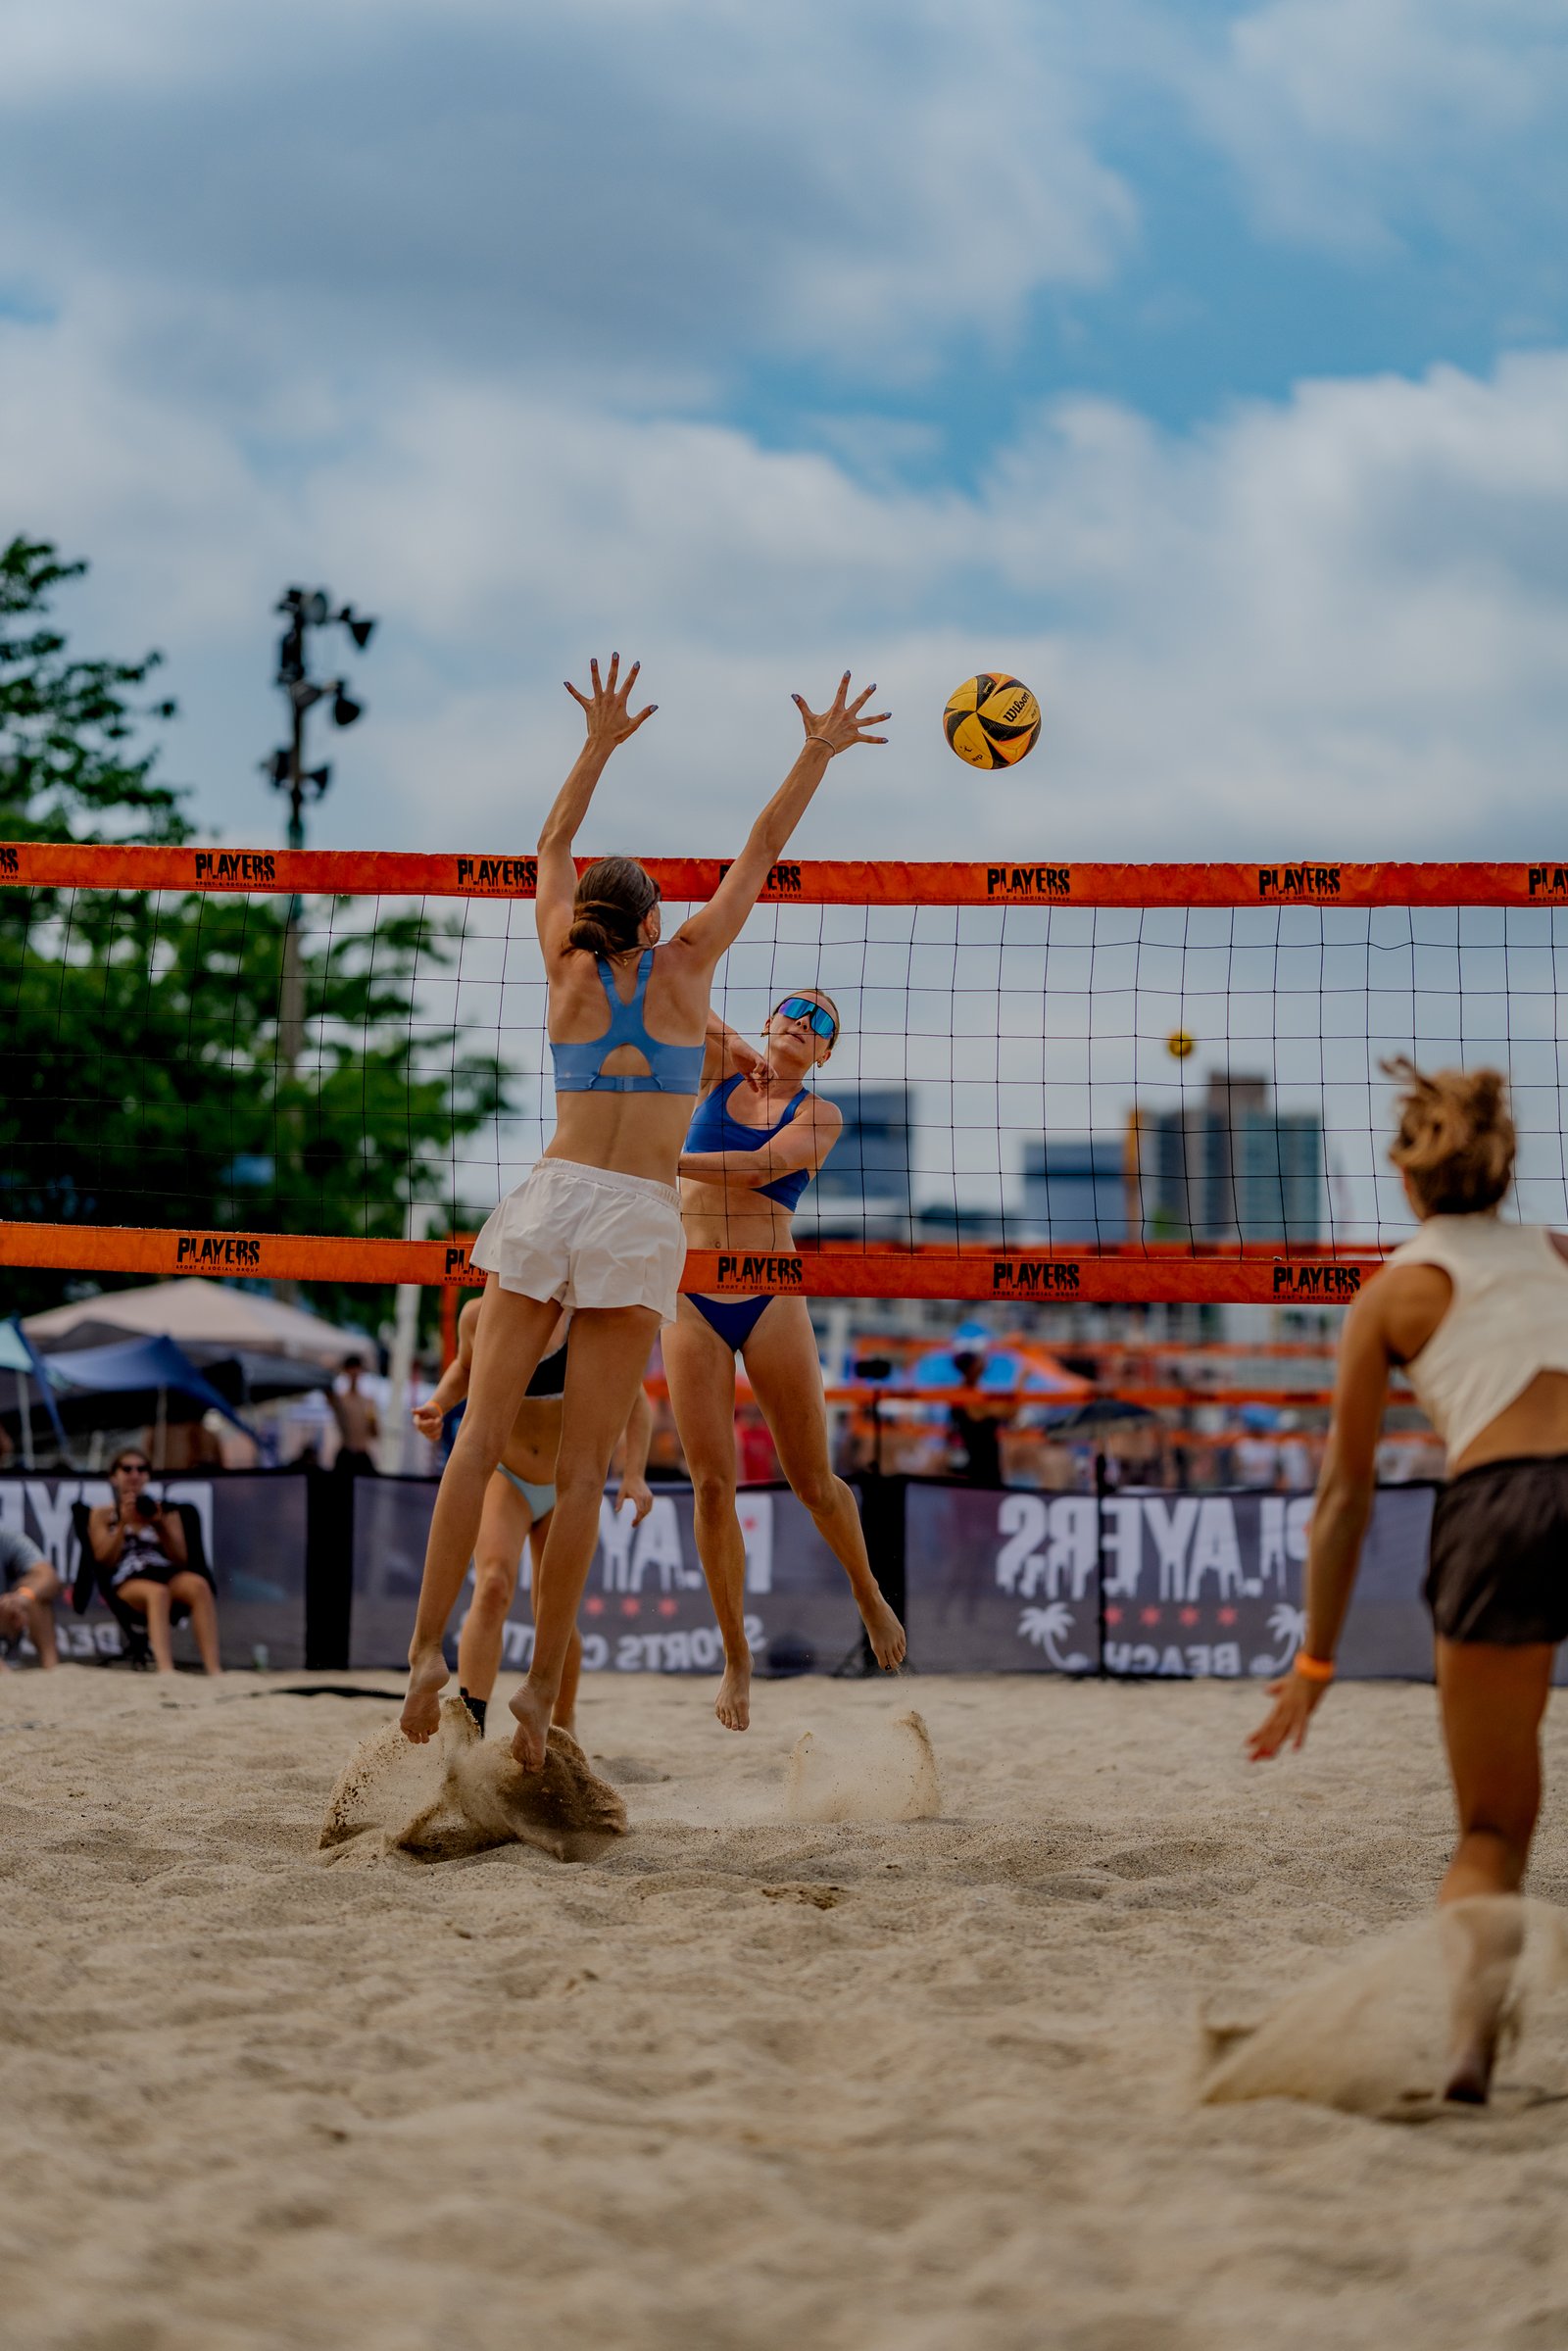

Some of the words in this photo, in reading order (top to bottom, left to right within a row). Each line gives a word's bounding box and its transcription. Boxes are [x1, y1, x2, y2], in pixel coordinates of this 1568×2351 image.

[1003, 691, 1030, 722] Wilson
[195, 854, 275, 881] PLAYERS
[457, 858, 538, 888] PLAYERS
[988, 868, 1070, 896] PLAYERS
[1258, 868, 1340, 896] PLAYERS
[176, 1237, 261, 1265] PLAYERS
[717, 1256, 803, 1285] PLAYERS
[993, 1262, 1080, 1290] PLAYERS
[1273, 1266, 1361, 1295] PLAYERS
